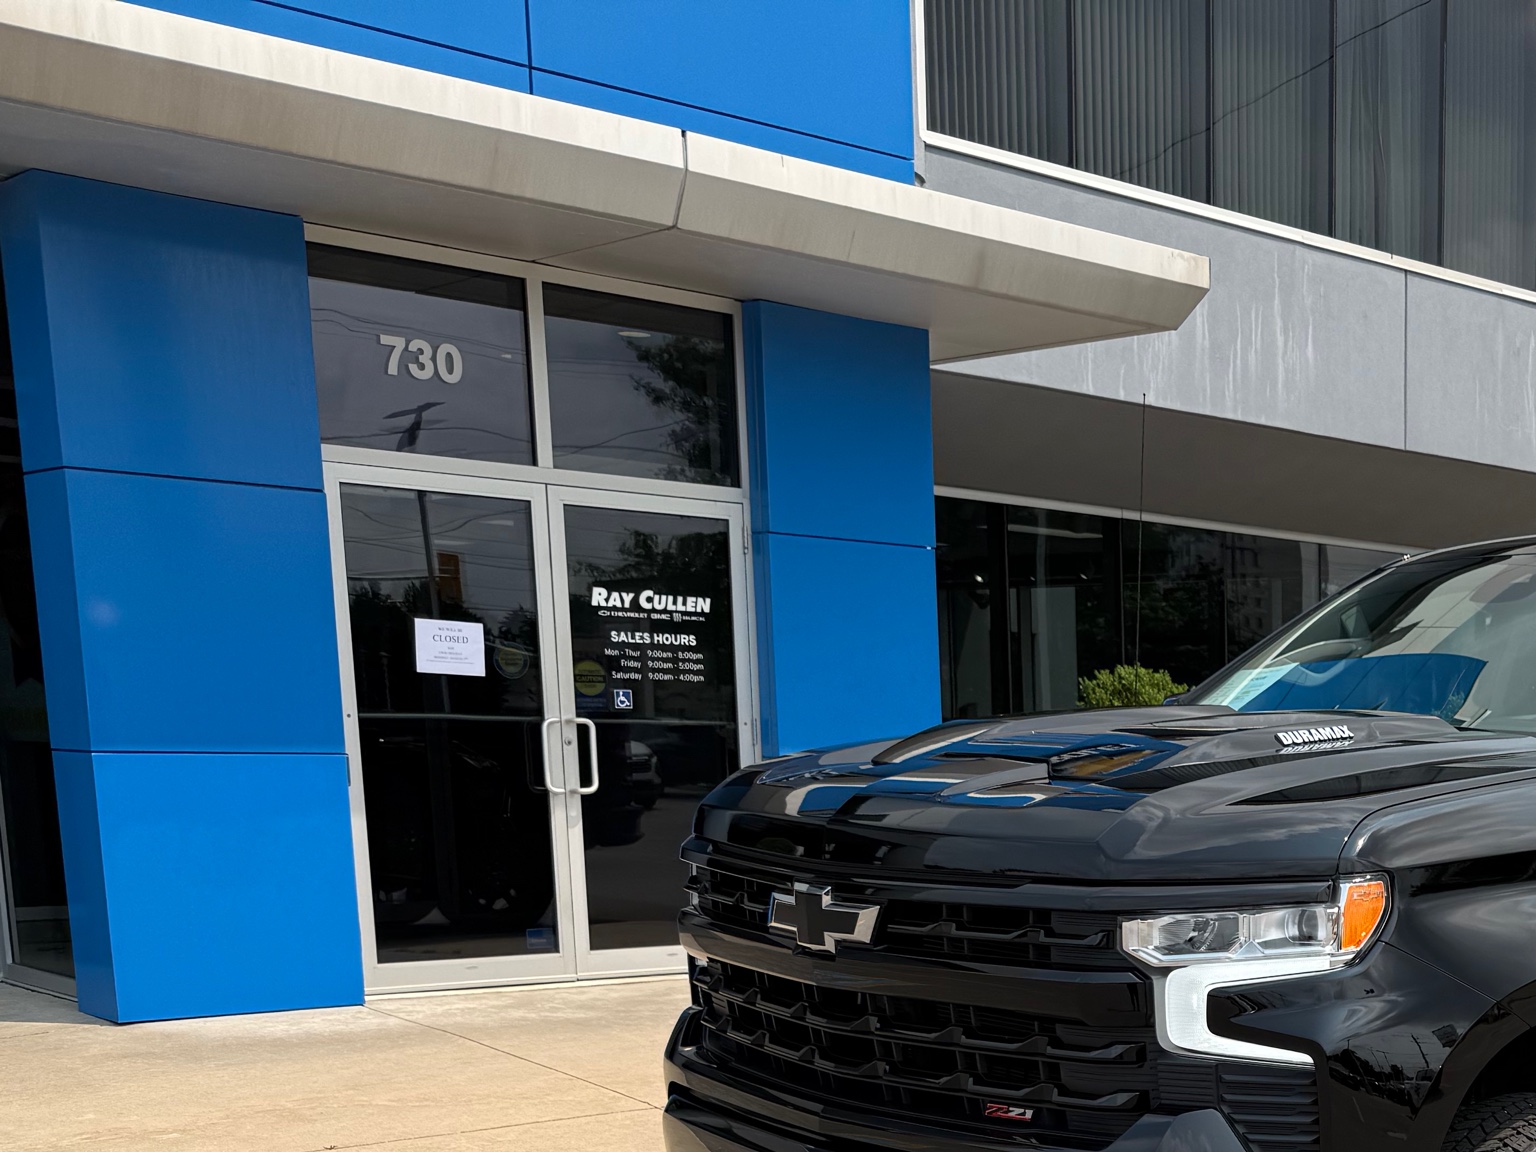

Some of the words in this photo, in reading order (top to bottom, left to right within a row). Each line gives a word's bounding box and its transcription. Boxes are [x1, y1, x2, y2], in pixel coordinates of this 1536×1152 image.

[380, 334, 462, 384] 730
[591, 587, 635, 608] RAY
[639, 590, 711, 613] CULLEN
[432, 634, 469, 644] CLOSED
[610, 631, 651, 643] SALES
[653, 633, 697, 646] HOURS
[604, 648, 619, 656] Mon
[625, 649, 640, 657] Thur
[647, 650, 673, 658] 9:00am
[621, 659, 642, 669] Friday
[647, 661, 673, 669] 9:00am
[678, 662, 705, 671] 5:00pm
[611, 671, 642, 681] Saturday
[648, 672, 674, 680] 9:00am
[679, 673, 705, 682] 4:00pm
[1276, 725, 1354, 746] DURAMAX
[985, 1103, 1034, 1122] Z71
